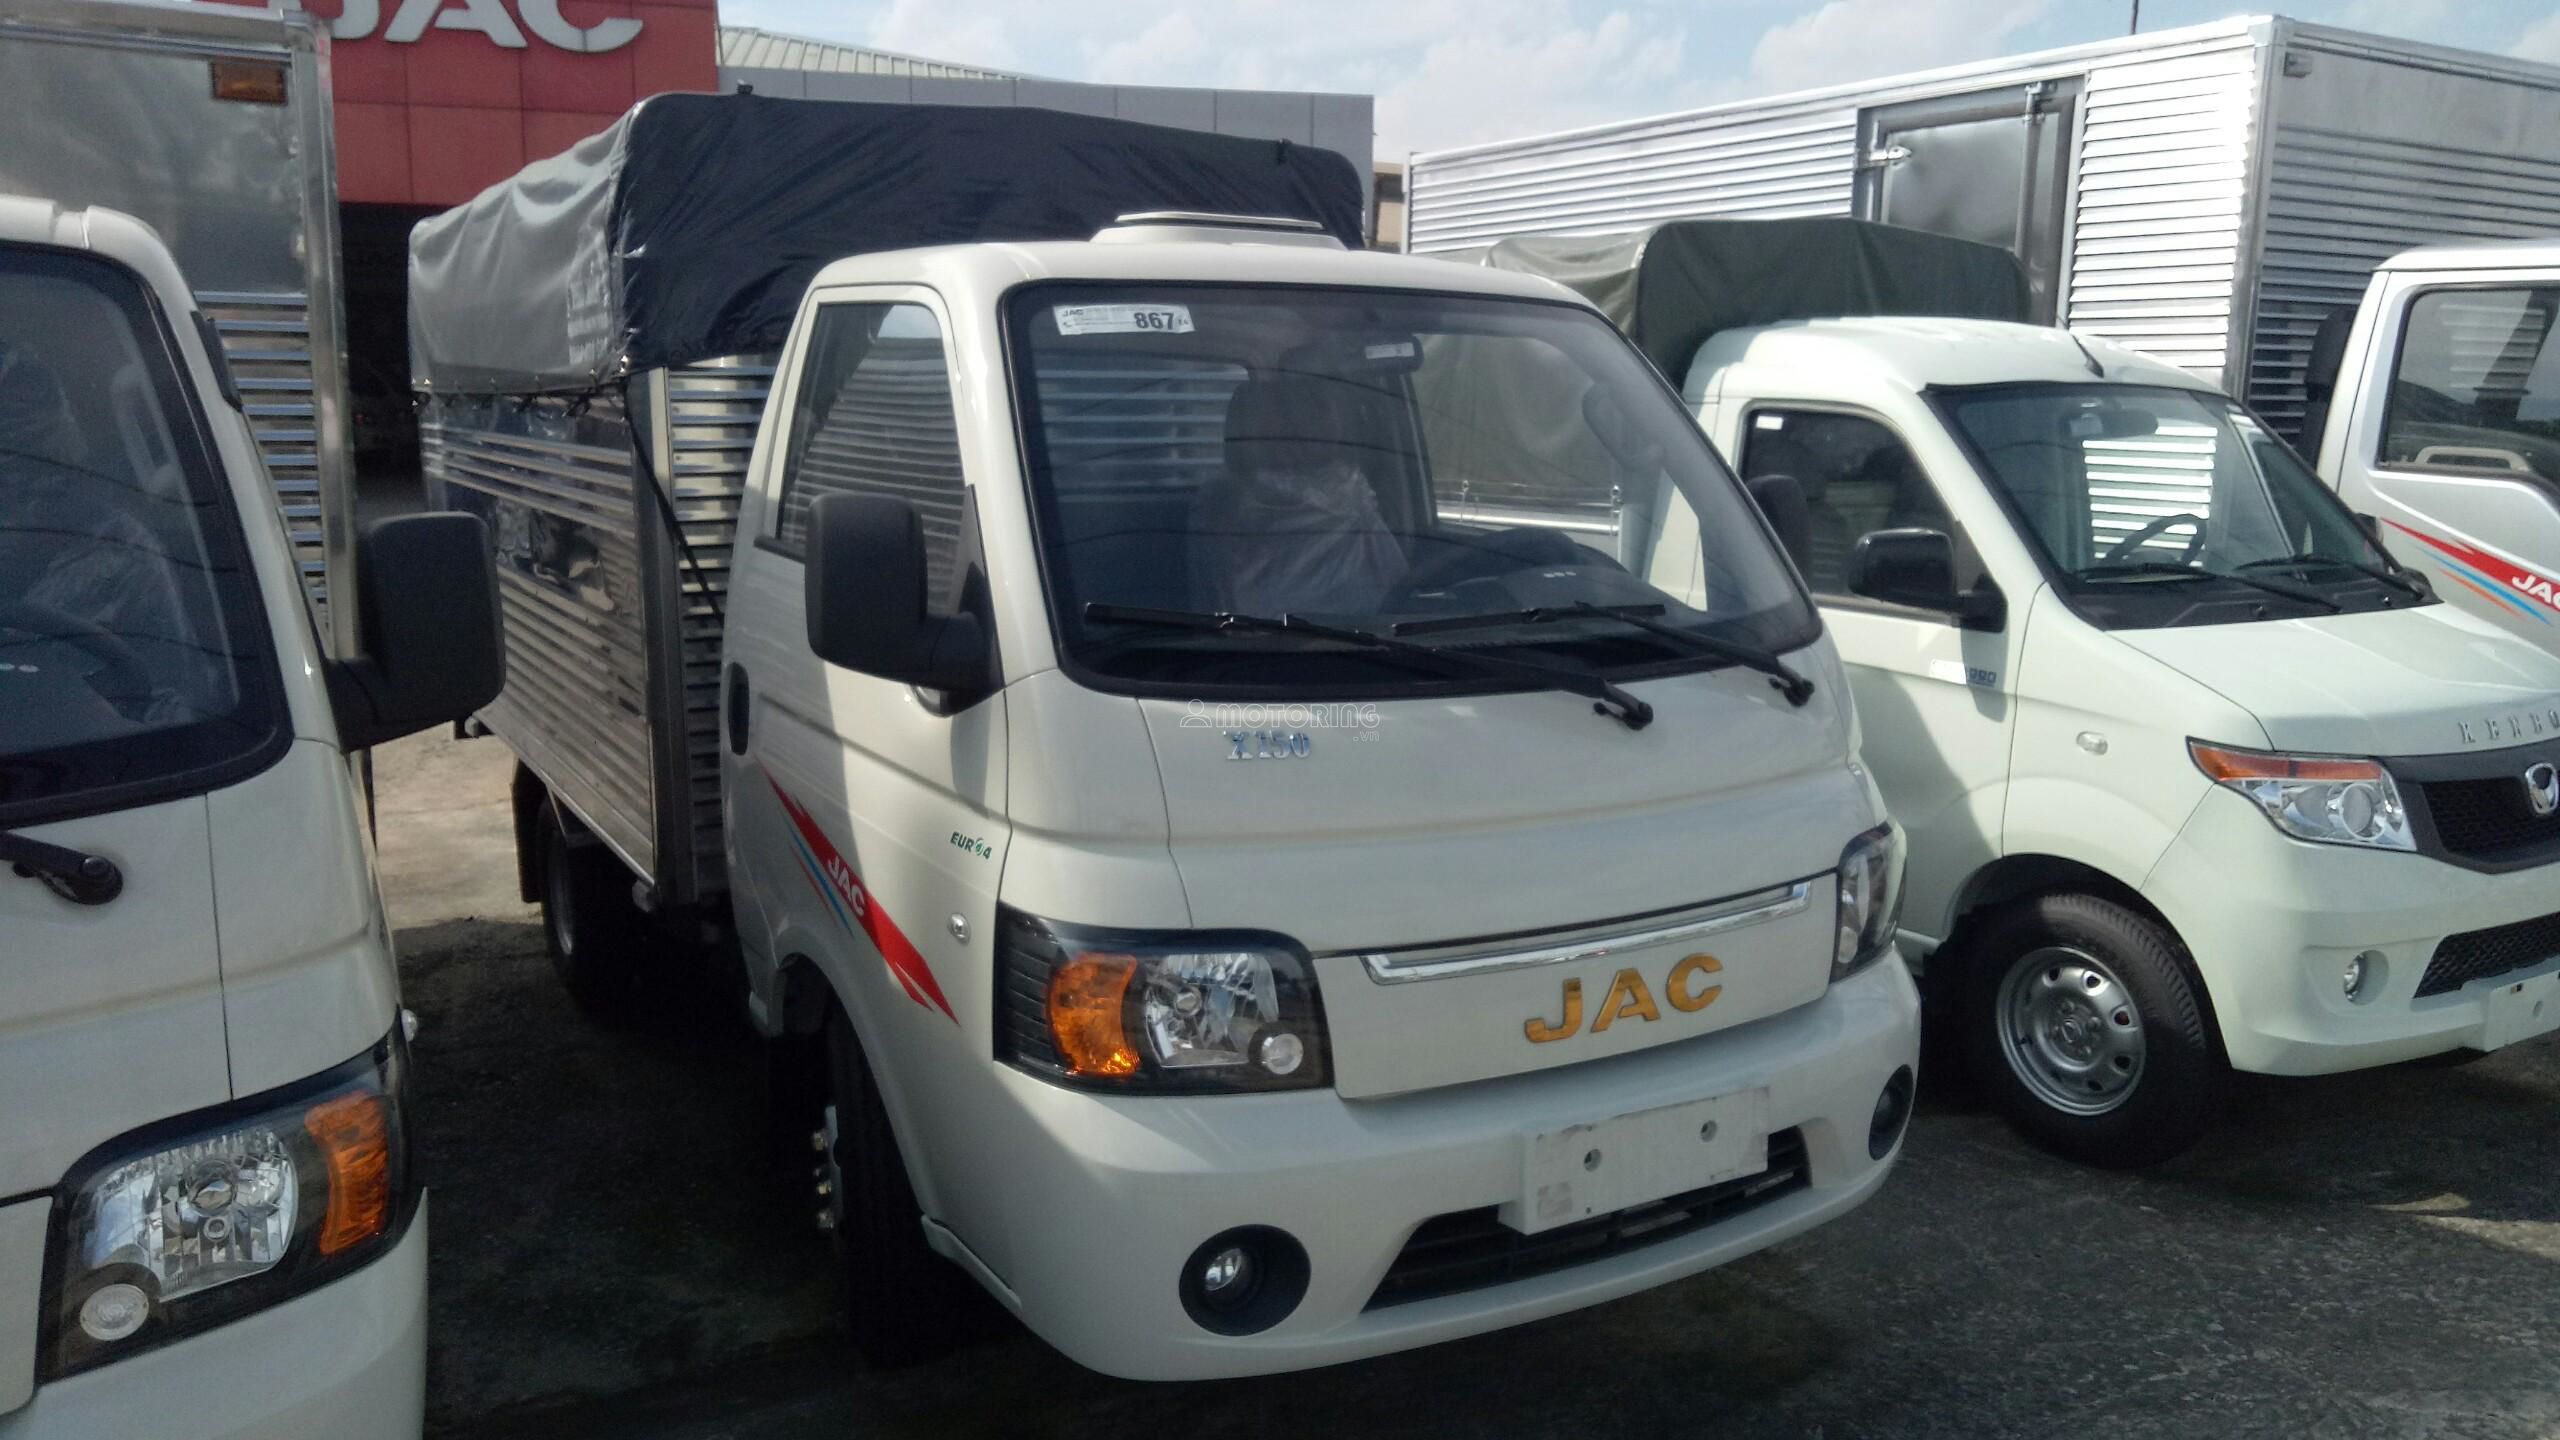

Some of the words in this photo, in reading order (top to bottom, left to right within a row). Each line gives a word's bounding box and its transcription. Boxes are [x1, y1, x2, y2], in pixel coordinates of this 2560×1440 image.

[1134, 312, 1174, 330] 867
[826, 855, 866, 917] JAC
[1524, 952, 1724, 1043] JAC
